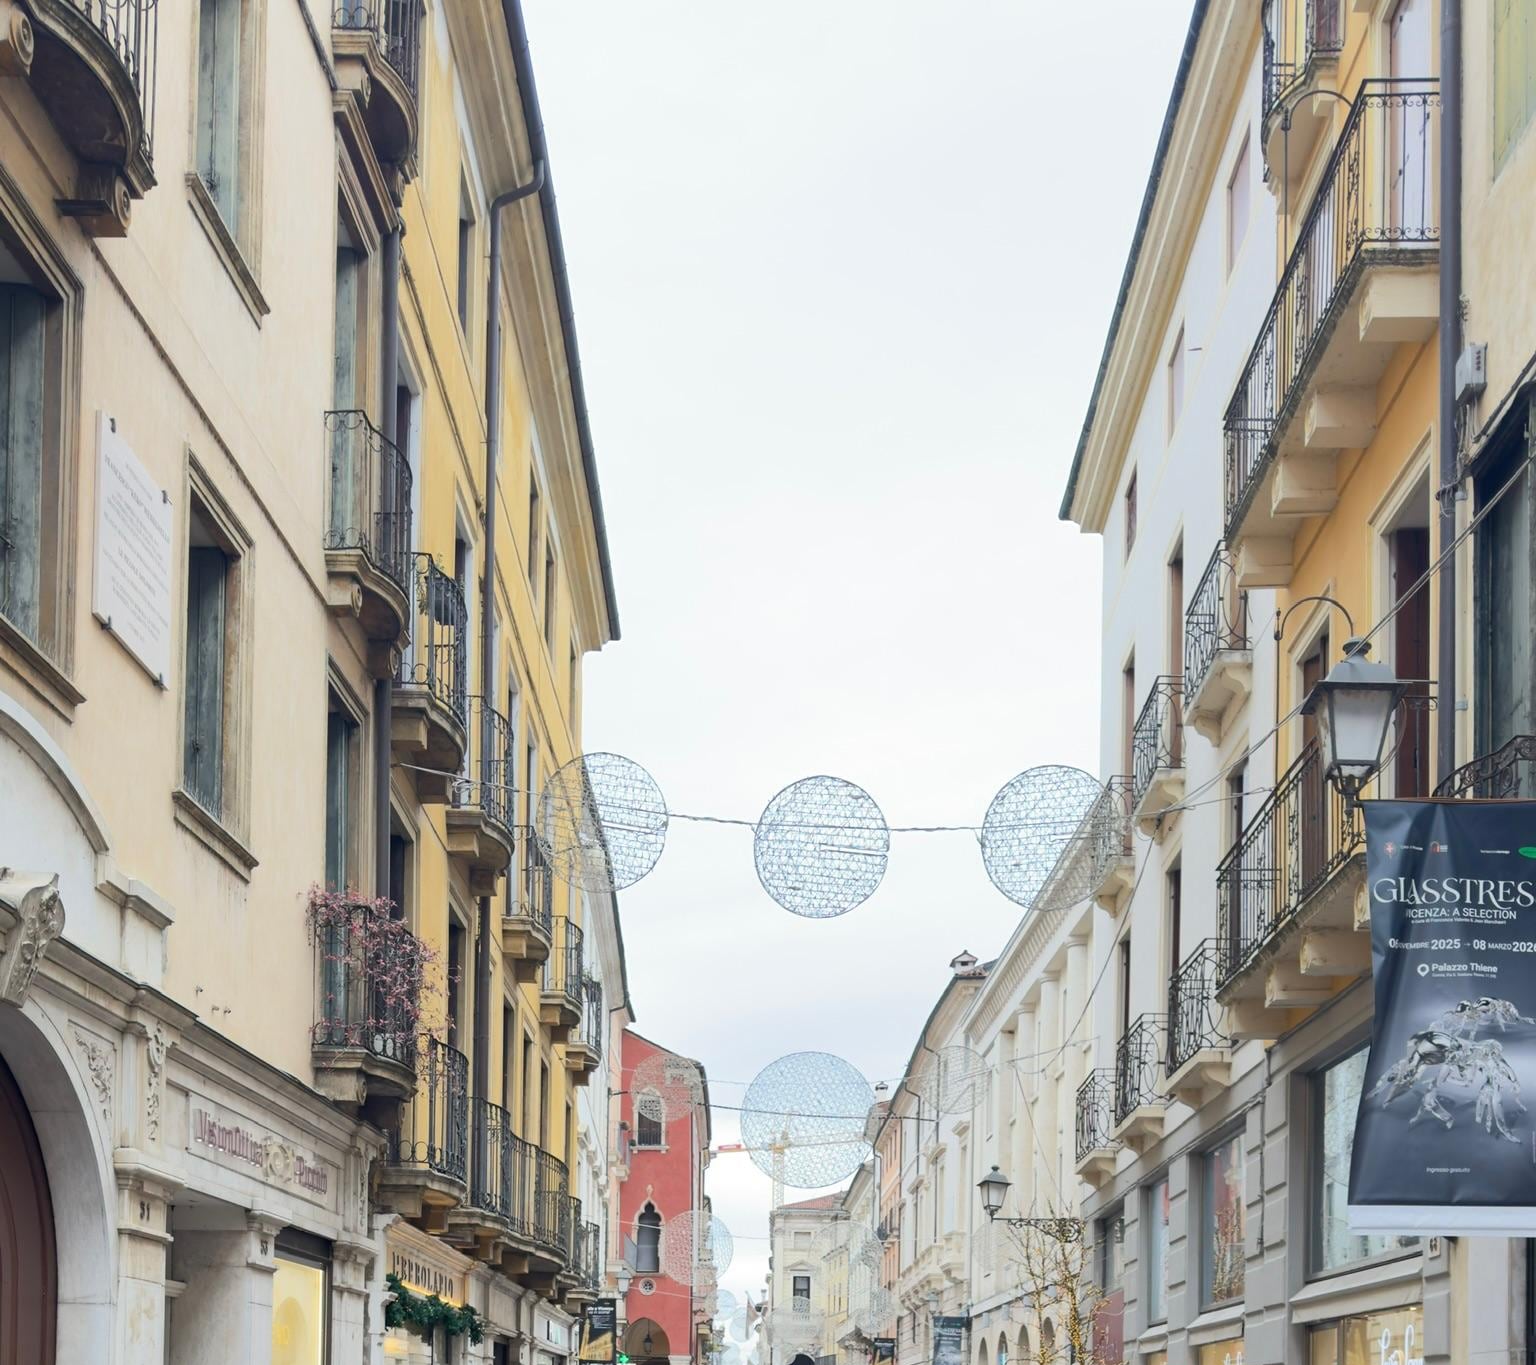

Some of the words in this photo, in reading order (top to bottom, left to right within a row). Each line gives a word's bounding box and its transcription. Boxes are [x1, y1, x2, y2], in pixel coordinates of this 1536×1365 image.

[1373, 877, 1536, 910] GLASSTRES
[1452, 907, 1460, 916] A
[1462, 907, 1517, 919] SELECTION
[1431, 939, 1461, 950] 2025
[1473, 939, 1486, 950] 08
[1488, 943, 1513, 951] MARZO
[1432, 963, 1468, 972] Palazzo
[1470, 962, 1498, 973] Thiene
